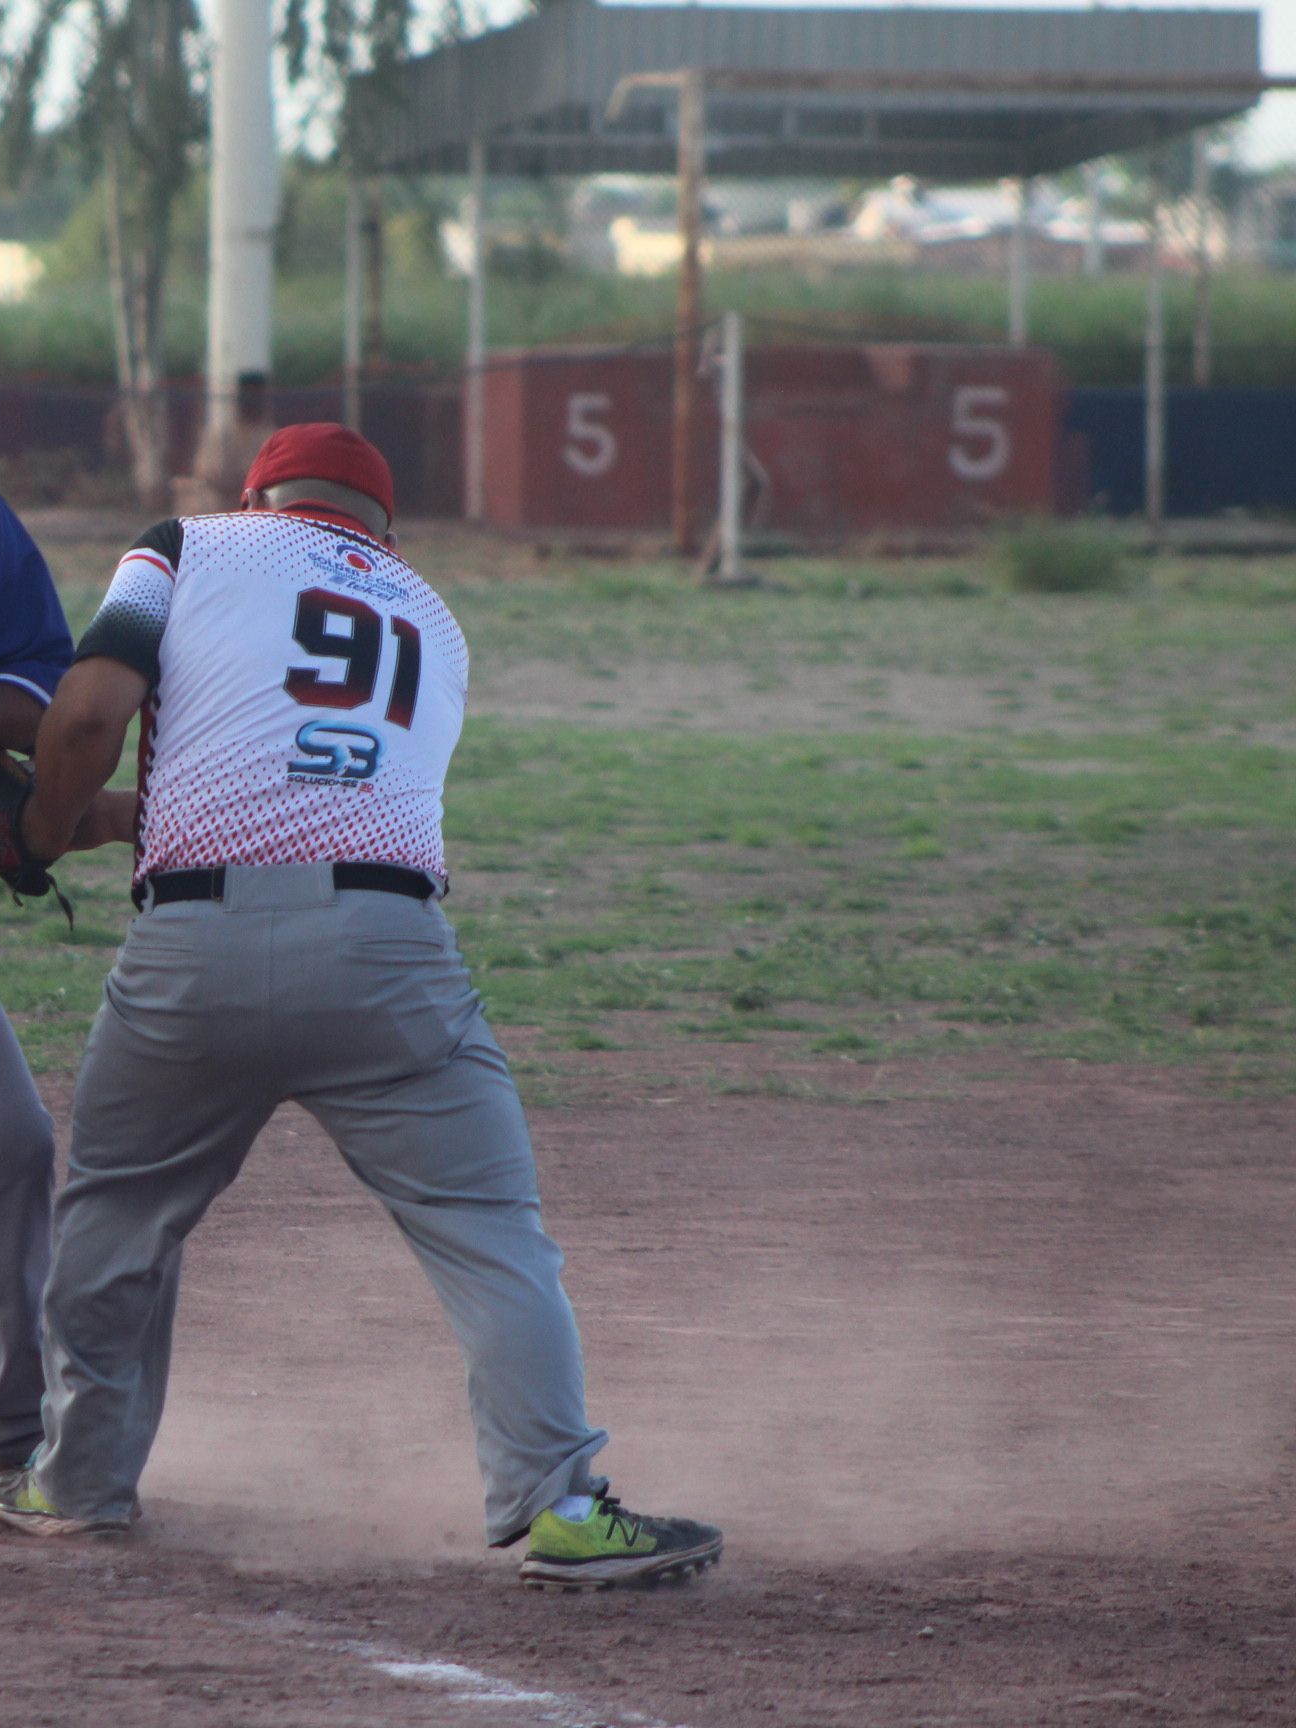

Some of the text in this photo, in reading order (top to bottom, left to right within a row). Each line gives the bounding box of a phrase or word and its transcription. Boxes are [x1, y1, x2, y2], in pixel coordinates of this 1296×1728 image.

[561, 394, 617, 476] 5
[948, 387, 1010, 479] 5
[346, 581, 395, 602] telcel
[283, 586, 422, 731] 91
[286, 774, 359, 788] SOLUCIONES
